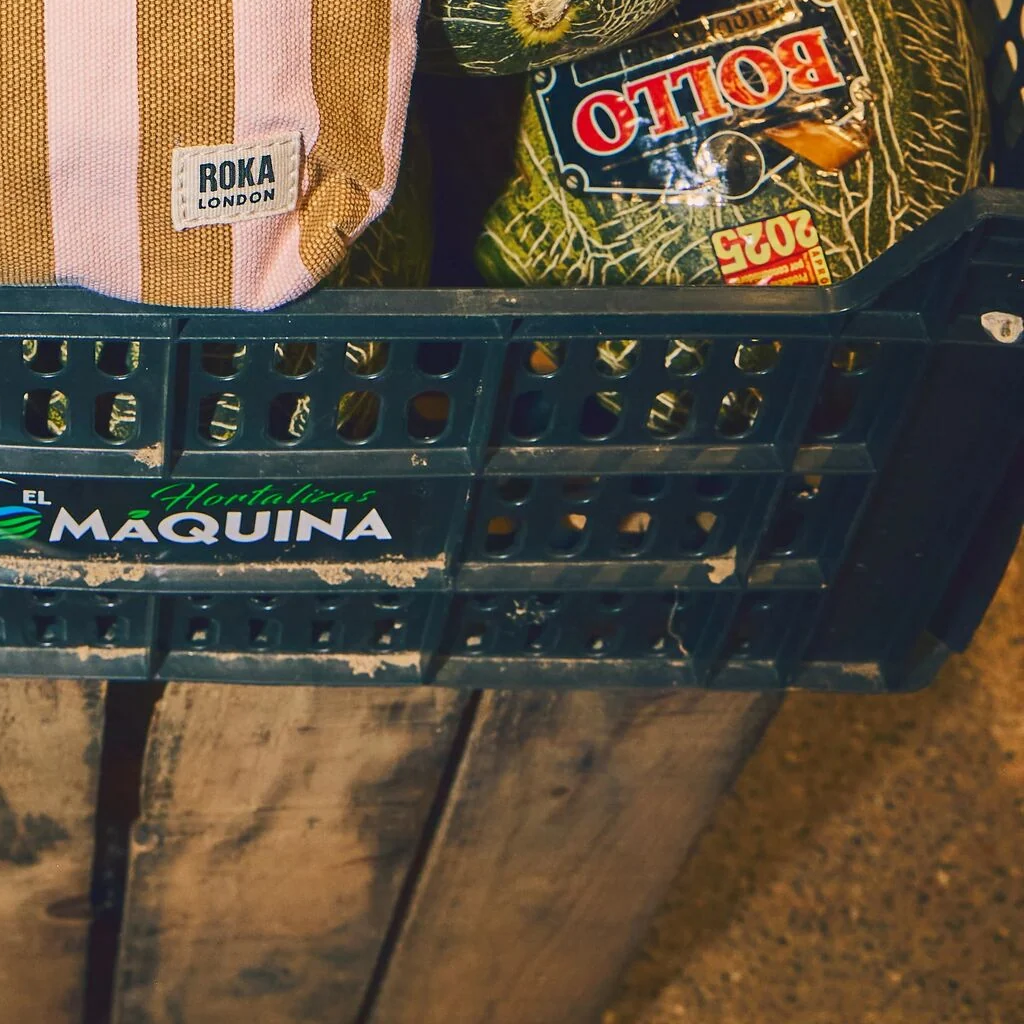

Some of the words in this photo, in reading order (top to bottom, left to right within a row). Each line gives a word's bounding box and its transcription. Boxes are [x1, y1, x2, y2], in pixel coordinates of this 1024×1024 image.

[572, 26, 846, 156] BOLLO
[199, 154, 275, 193] ROKA
[198, 188, 275, 210] LONDON
[712, 210, 819, 274] 2025
[22, 489, 52, 505] EL
[151, 482, 378, 511] Hortalizas
